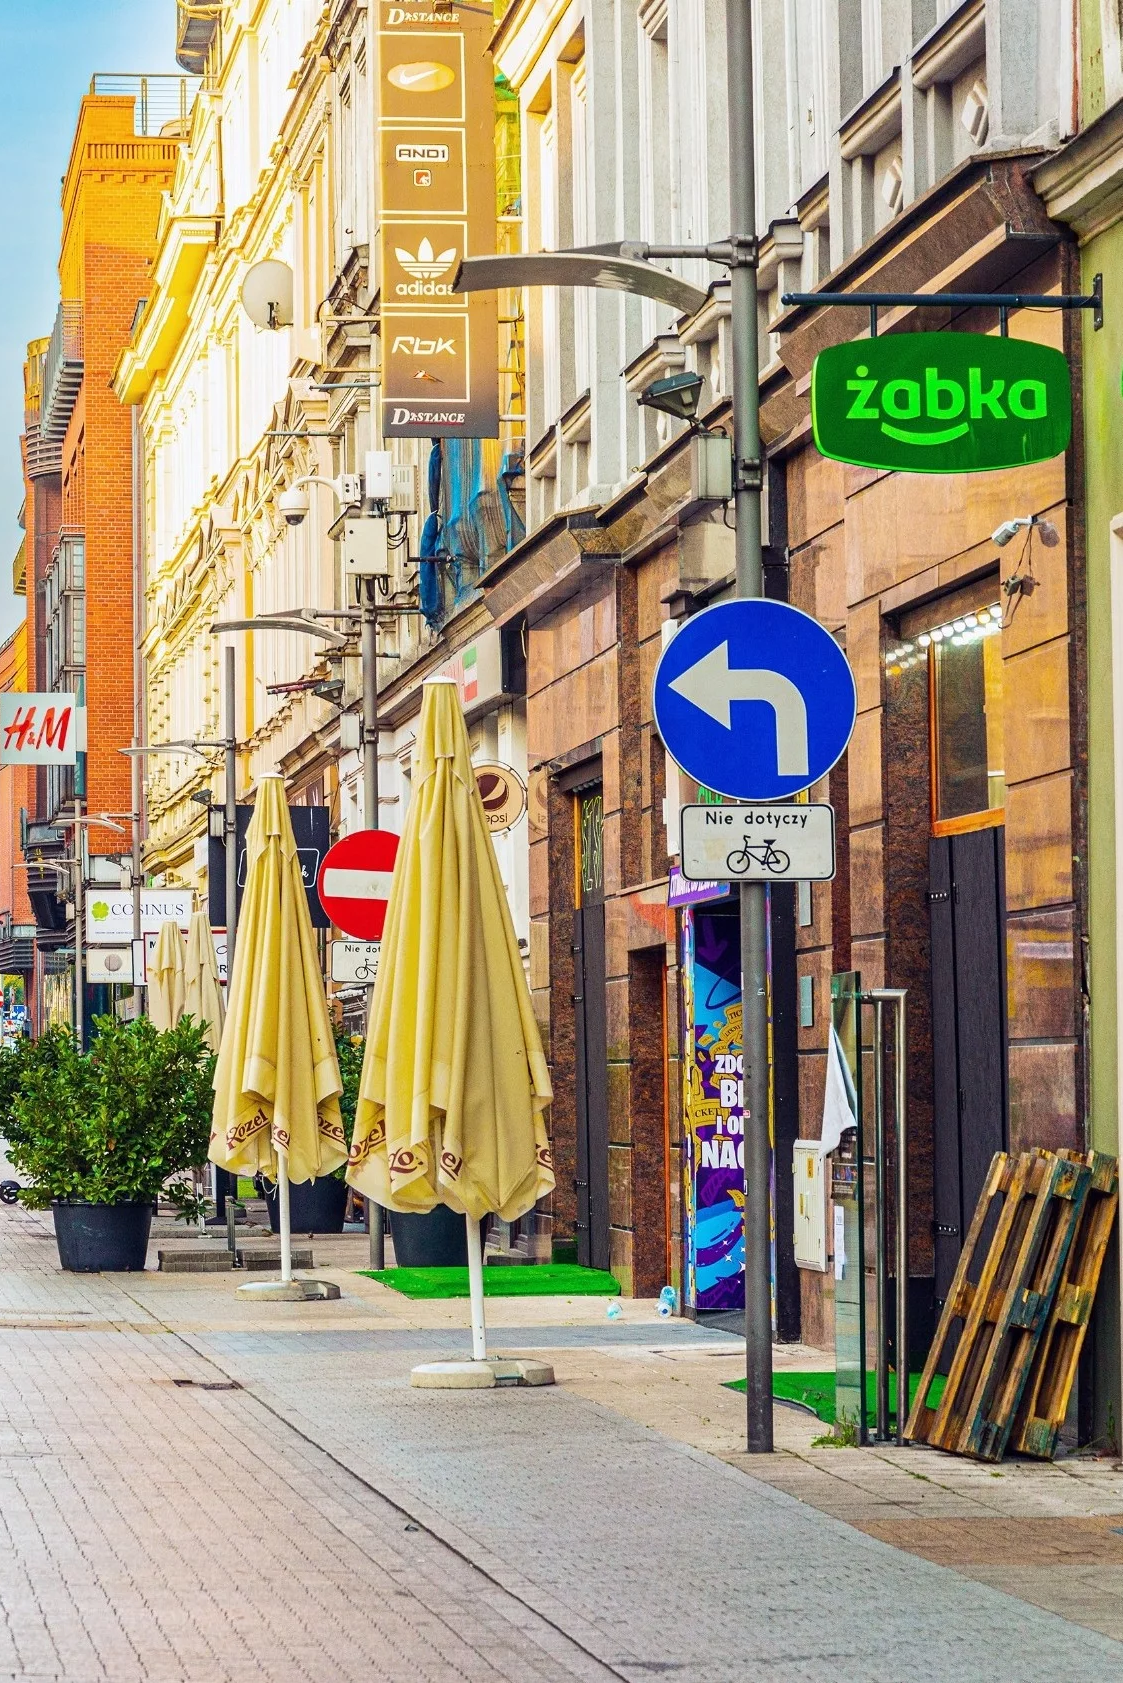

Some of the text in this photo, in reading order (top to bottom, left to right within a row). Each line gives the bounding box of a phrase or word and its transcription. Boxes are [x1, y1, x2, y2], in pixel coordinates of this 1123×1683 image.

[399, 148, 445, 159] AND1
[396, 279, 455, 296] adidas
[846, 365, 1047, 420] żabka
[4, 706, 72, 752] H&M
[485, 813, 508, 825] epsi
[706, 811, 808, 829] Nie dotyczy
[344, 945, 360, 953] Nie
[695, 1107, 721, 1119] CKET
[227, 1108, 269, 1151] Kozel
[348, 1120, 385, 1166] ozel
